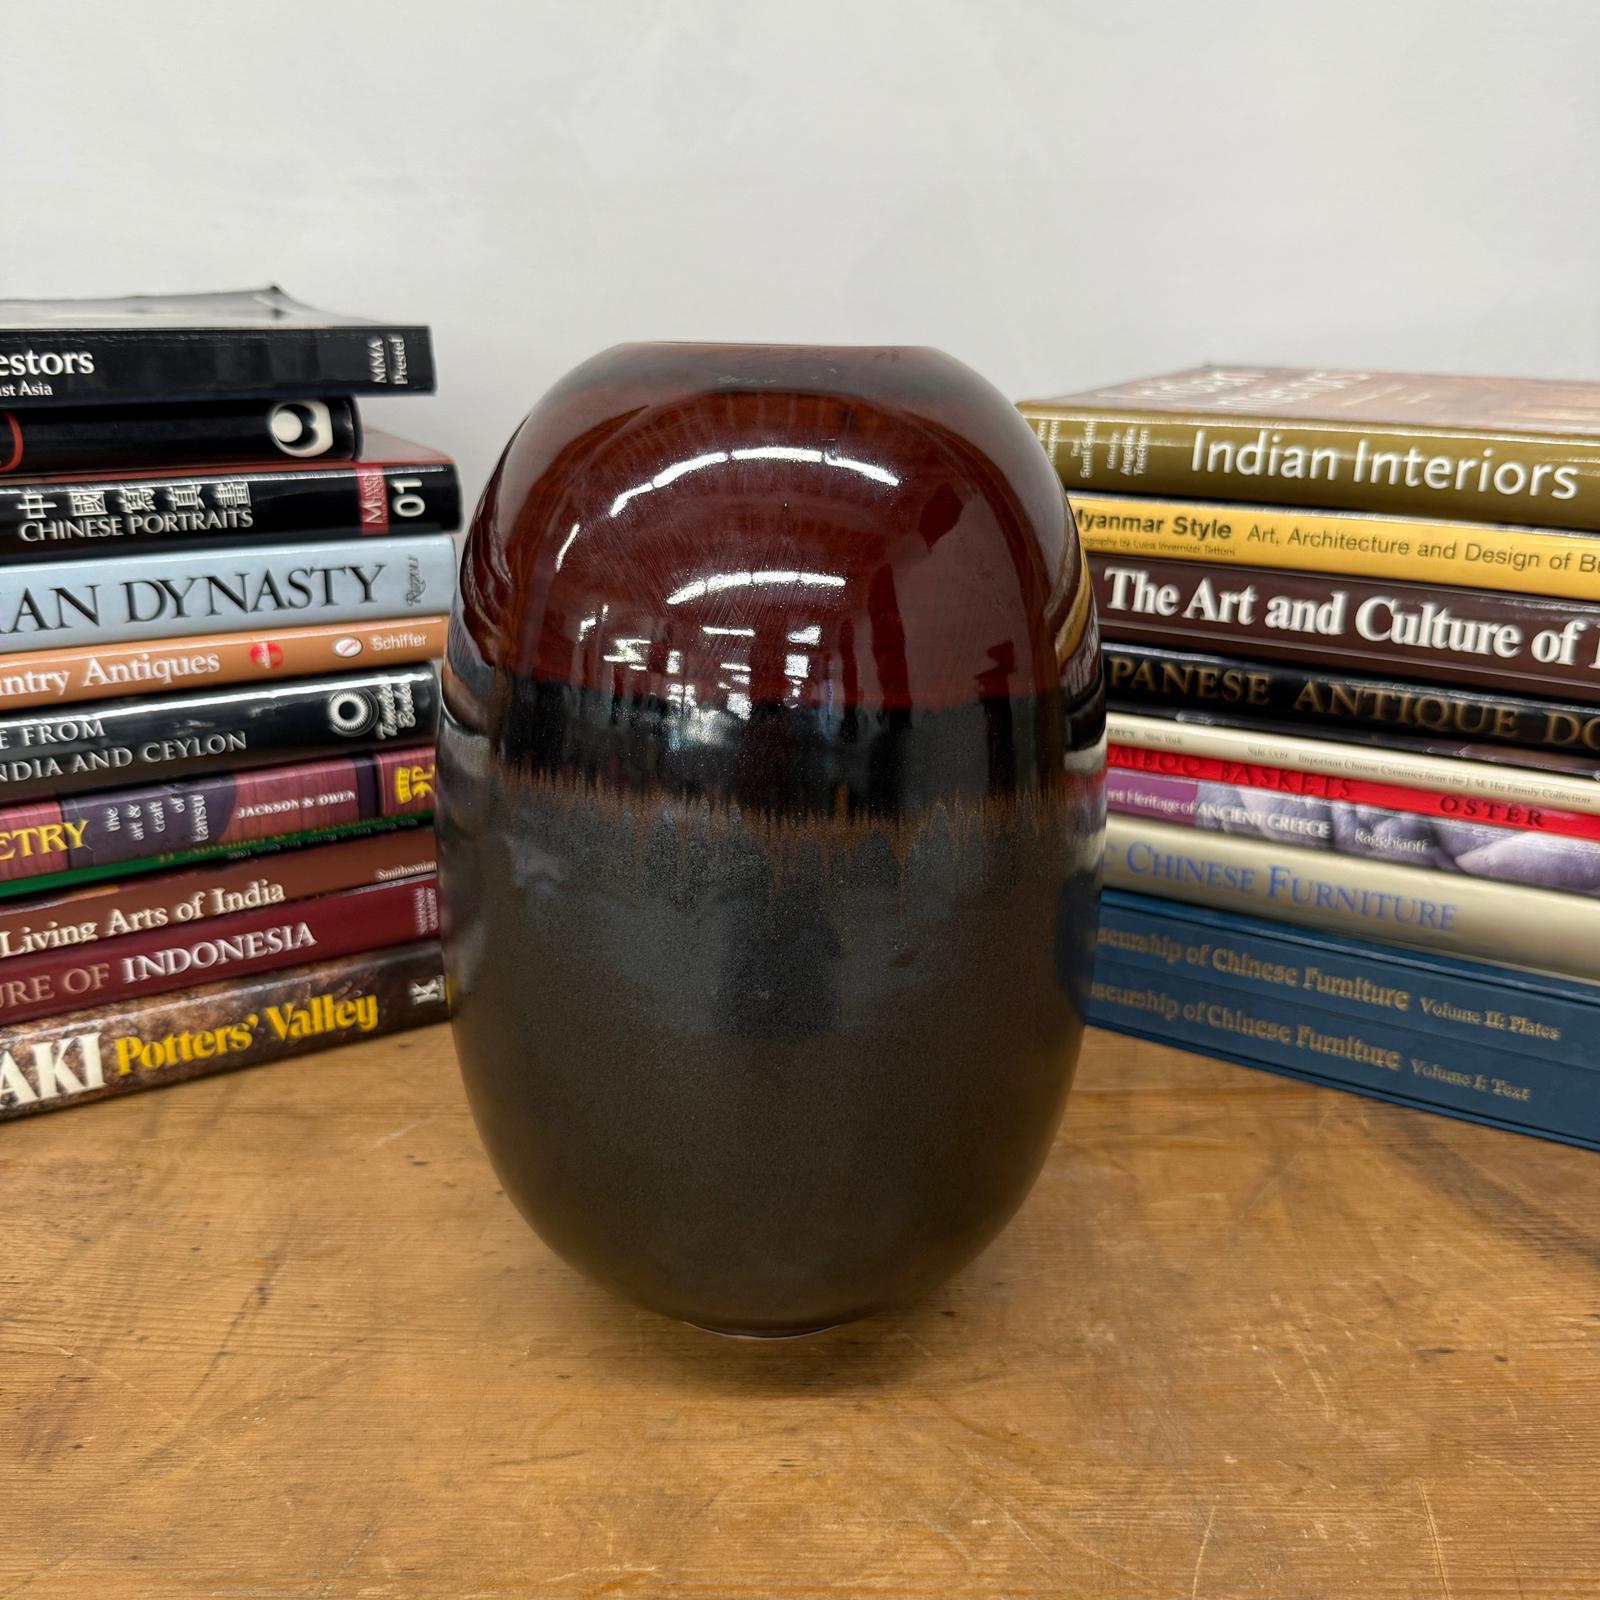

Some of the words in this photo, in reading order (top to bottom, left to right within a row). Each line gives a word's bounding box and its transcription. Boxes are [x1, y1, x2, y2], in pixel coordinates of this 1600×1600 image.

[368, 336, 387, 383] MMA
[19, 380, 53, 396] Asia
[1080, 450, 1093, 478] Sunil
[1191, 430, 1340, 481] Indian
[1352, 438, 1580, 501] Interiors
[391, 478, 425, 517] 01
[20, 516, 123, 542] CHINESE
[129, 509, 253, 535] PORTRAITS
[1172, 516, 1232, 541] Style
[1247, 524, 1279, 545] Art,
[1287, 527, 1411, 556] Architecture
[1417, 541, 1458, 561] and
[1464, 543, 1540, 572] Design
[1549, 552, 1573, 571] of
[1578, 554, 1600, 573] B
[0, 587, 100, 635] AN
[120, 563, 388, 624] DYNASTY
[1104, 567, 1180, 617] The
[1181, 577, 1259, 626] Art
[1264, 590, 1349, 636] and
[1355, 595, 1524, 659] Culture
[1531, 619, 1589, 666] of
[370, 632, 428, 652] Schiffer
[82, 653, 221, 686] Antiques
[1292, 678, 1521, 739] ANTIQUE
[20, 720, 107, 747] FROM
[72, 747, 133, 773] AND
[140, 730, 248, 763] CEYLON
[1344, 759, 1379, 773] Chinese
[1424, 771, 1447, 783] from
[1449, 773, 1463, 785] the
[1507, 784, 1540, 797] Family
[1542, 788, 1592, 804] Collection
[104, 807, 120, 832] the
[127, 804, 142, 818] &
[190, 794, 209, 842] tansu
[236, 799, 299, 820] JACKSON
[302, 797, 315, 808] &
[319, 790, 356, 806] OWEN
[1181, 797, 1195, 815] of
[1197, 802, 1263, 827] ANCIENT
[1267, 813, 1331, 839] GREECE
[1440, 795, 1545, 827] OSTER
[1126, 840, 1256, 895] CHINESE
[1268, 865, 1457, 933] FURNITURE
[0, 921, 98, 958] Living
[107, 909, 169, 937] Arts
[176, 891, 206, 920] of
[212, 879, 286, 912] India
[63, 963, 111, 994] OF
[120, 922, 318, 984] INDONESIA
[1186, 944, 1210, 967] of
[1212, 948, 1299, 988] Chinese
[1302, 966, 1410, 1012] Furniture
[1419, 997, 1481, 1024] Volume
[1507, 1016, 1561, 1041] Plates
[0, 1032, 107, 1109] AKI
[114, 1012, 260, 1077] Potters'
[264, 994, 380, 1041] Valley
[1184, 1002, 1206, 1024] of
[1207, 1005, 1294, 1043] Chinese
[1296, 1025, 1403, 1071] Furniture
[1410, 1058, 1471, 1088] Volume
[1491, 1079, 1532, 1101] Text
